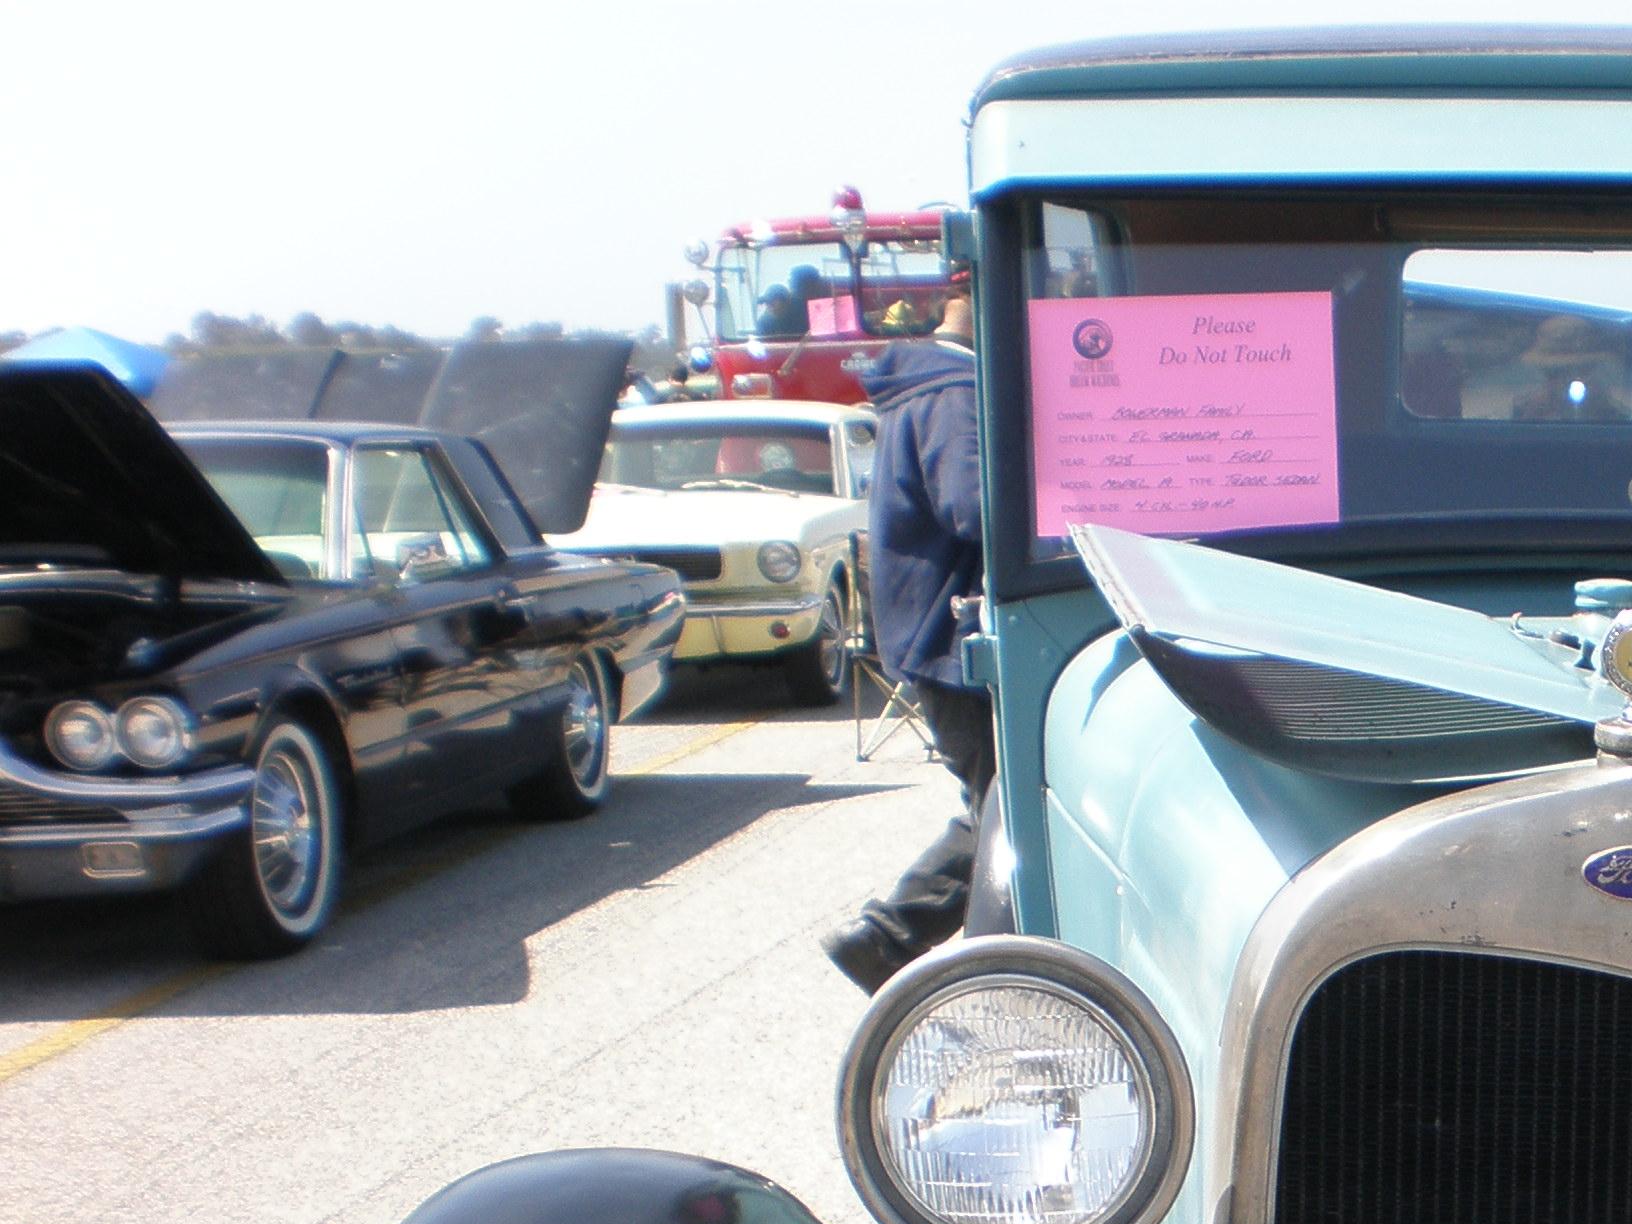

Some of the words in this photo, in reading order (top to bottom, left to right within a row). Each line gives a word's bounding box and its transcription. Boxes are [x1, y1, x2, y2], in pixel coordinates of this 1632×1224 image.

[1192, 316, 1255, 335] Please
[1158, 347, 1187, 365] Do
[1194, 346, 1226, 365] Not
[1235, 344, 1292, 363] Touch
[1198, 402, 1246, 418] FAMILY
[1228, 450, 1274, 464] FORD
